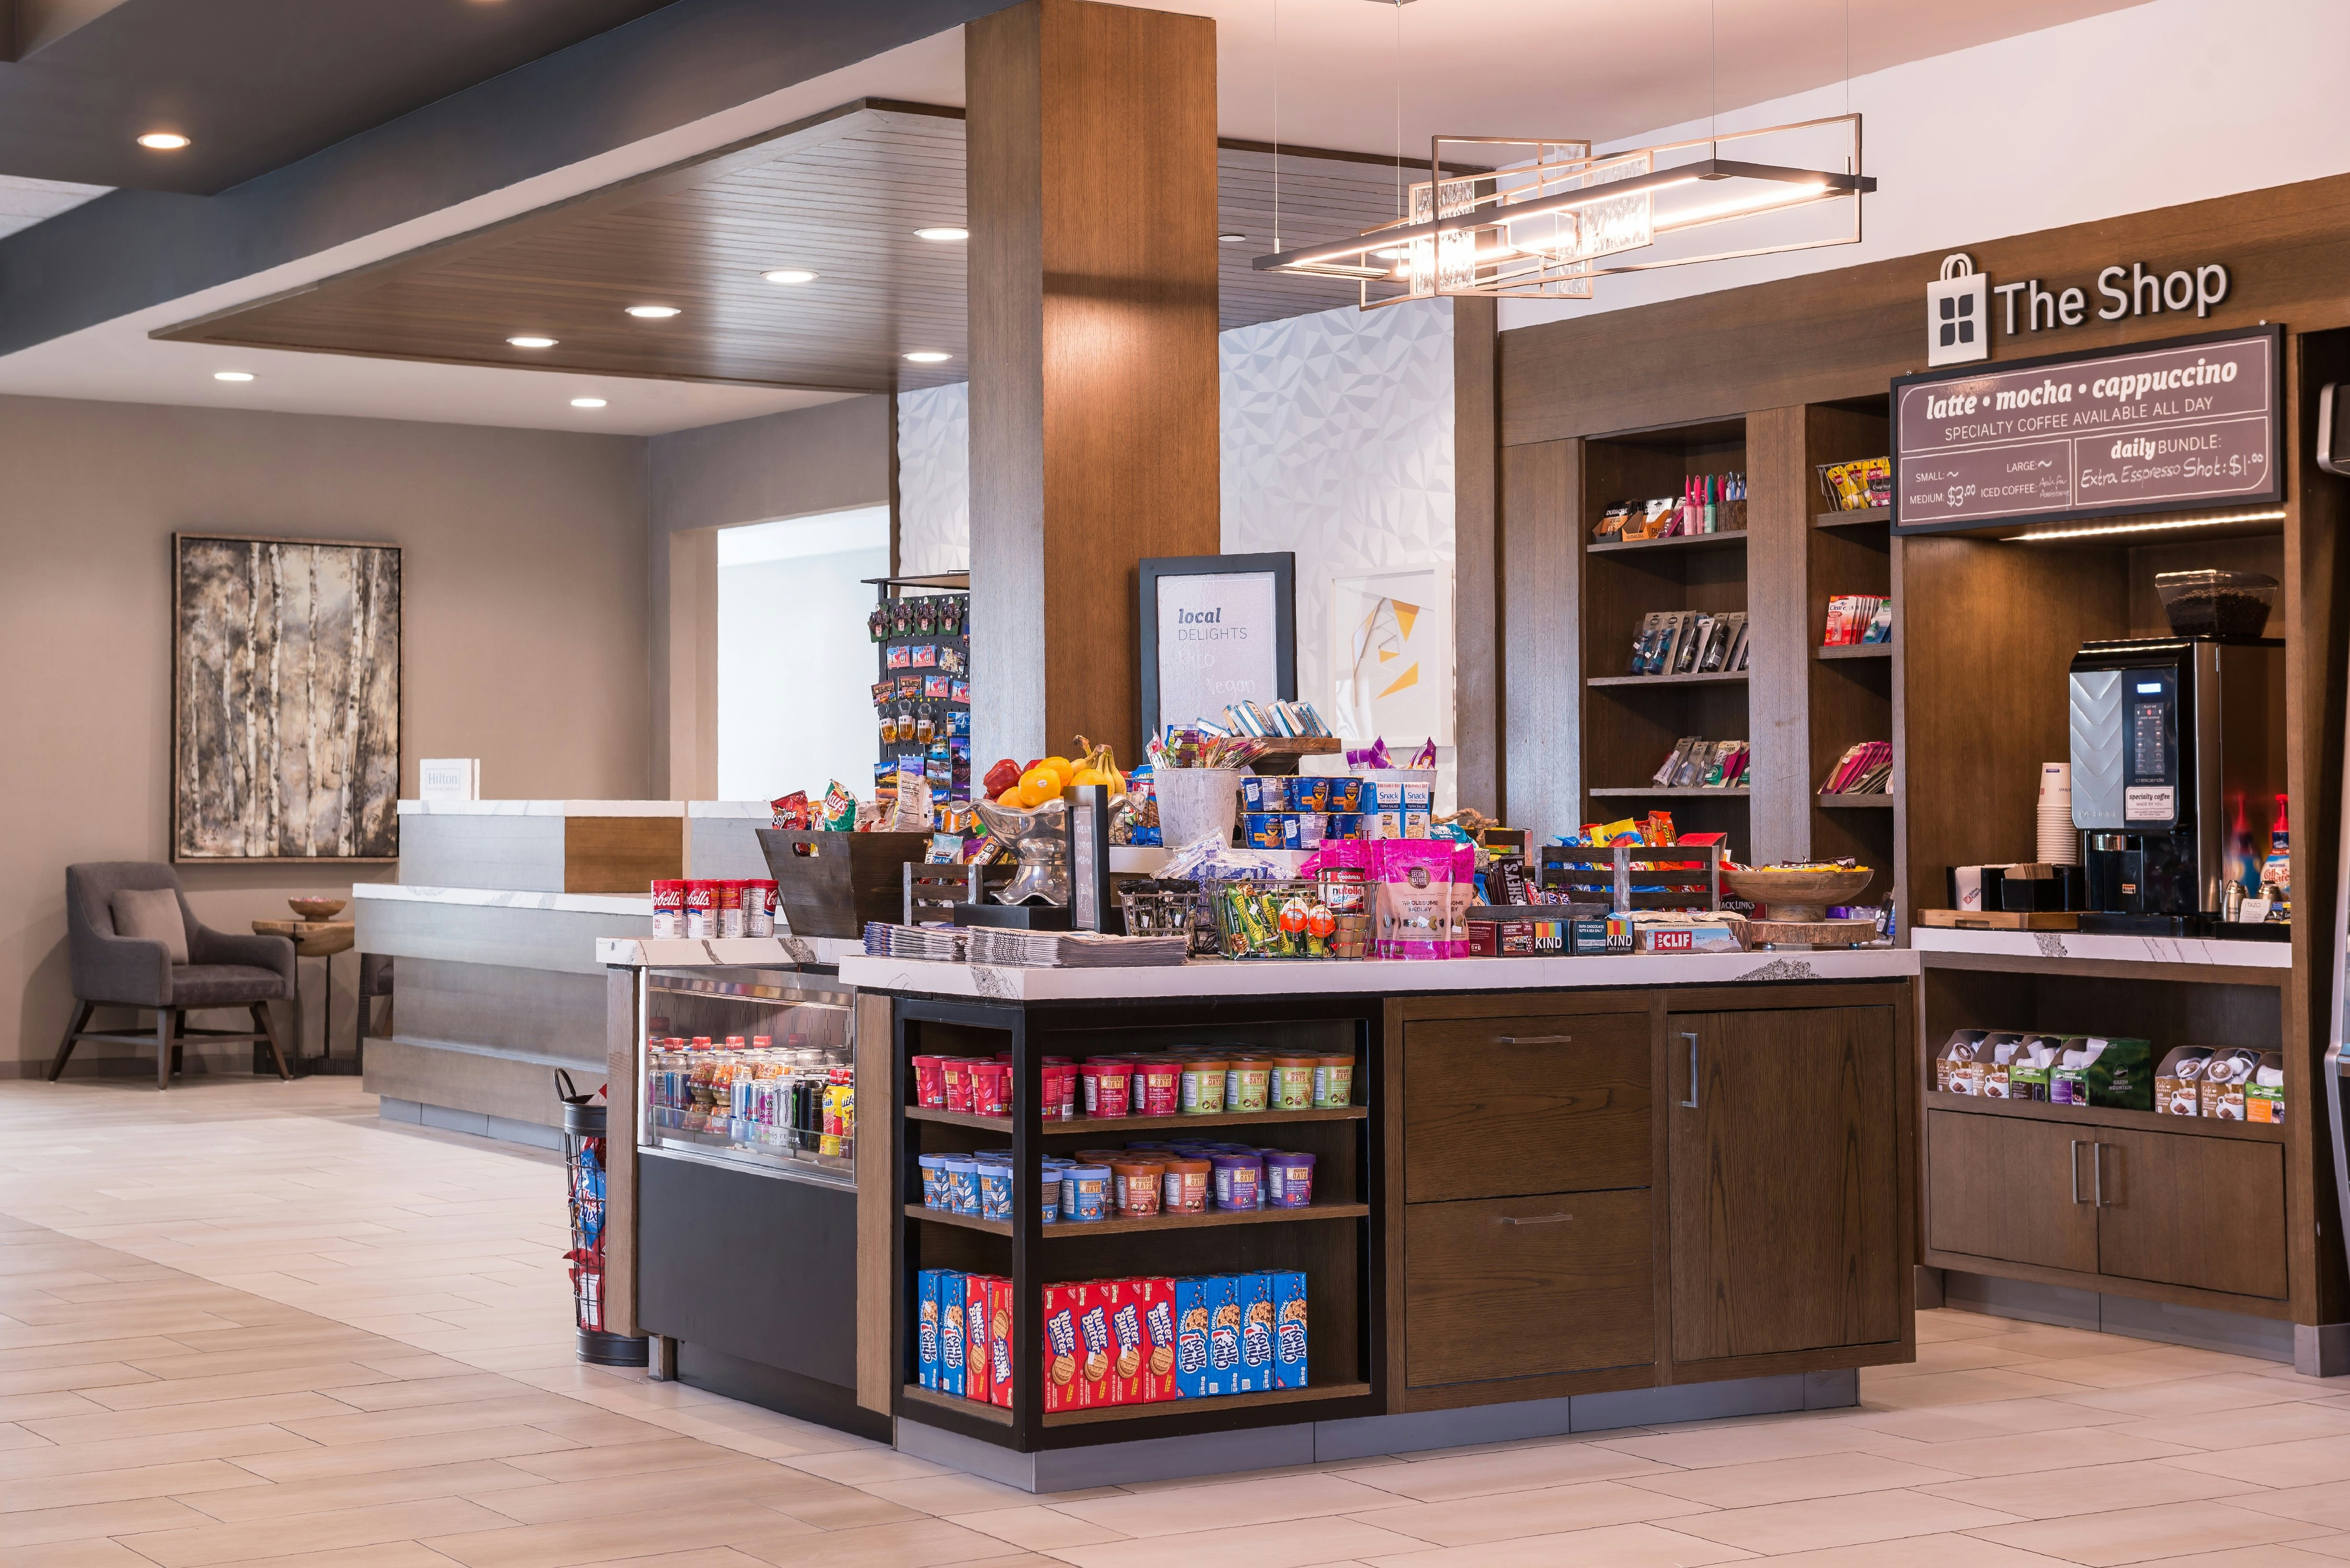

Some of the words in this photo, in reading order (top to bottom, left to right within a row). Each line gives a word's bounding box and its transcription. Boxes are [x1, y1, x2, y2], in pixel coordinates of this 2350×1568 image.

[1994, 279, 2087, 335] The
[2097, 262, 2229, 318] Shop
[1927, 394, 1977, 420] latte
[1996, 379, 2072, 410] mocha
[2092, 358, 2238, 402] cappuccino
[1945, 420, 2013, 441] SPECIALTY
[2017, 413, 2068, 432] COFFEE
[2073, 403, 2148, 425] AVAILABLE
[2152, 400, 2179, 416] ALL
[2185, 396, 2214, 412] DAY
[2111, 437, 2157, 460] daily
[2158, 434, 2222, 454] BUNDLE:
[1916, 471, 1945, 482] SMALL:
[2007, 460, 2037, 472] LARGE:
[2081, 468, 2118, 488] Extra
[2121, 464, 2181, 488] Esspresso
[1910, 492, 1945, 504] MEDIUM:
[1981, 488, 2000, 498] ICED
[2002, 483, 2037, 495] COFFEE:
[1178, 607, 1221, 624] local
[1178, 627, 1247, 641] DELIGHTS
[428, 773, 457, 785] Hilton
[1504, 863, 1524, 905] SHEY'S
[1535, 937, 1562, 949] KIND
[1607, 935, 1633, 947] KIND
[1663, 933, 1690, 947] CLIF
[765, 1098, 773, 1108] V8
[968, 1307, 981, 1347] Butter
[974, 1301, 984, 1343] Nutter
[1091, 1306, 1107, 1347] Nutter
[1124, 1304, 1140, 1344] Nutter
[1178, 1308, 1191, 1334] ORIGINAL
[1211, 1305, 1222, 1330] ORIGINAL
[1244, 1301, 1254, 1327] ORIGINAL
[1278, 1299, 1289, 1325] ORIGINAL
[1049, 1318, 1068, 1357] Butter
[1058, 1309, 1075, 1351] Nutter
[1082, 1315, 1101, 1354] Butter
[1114, 1311, 1132, 1351] Butter
[1148, 1309, 1166, 1348] Butter
[922, 1330, 932, 1363] Chips
[945, 1335, 956, 1368] Chips
[1182, 1341, 1197, 1373] Chips
[1213, 1337, 1229, 1369] Chips
[1246, 1334, 1262, 1366] Chips
[1281, 1332, 1297, 1364] Chips
